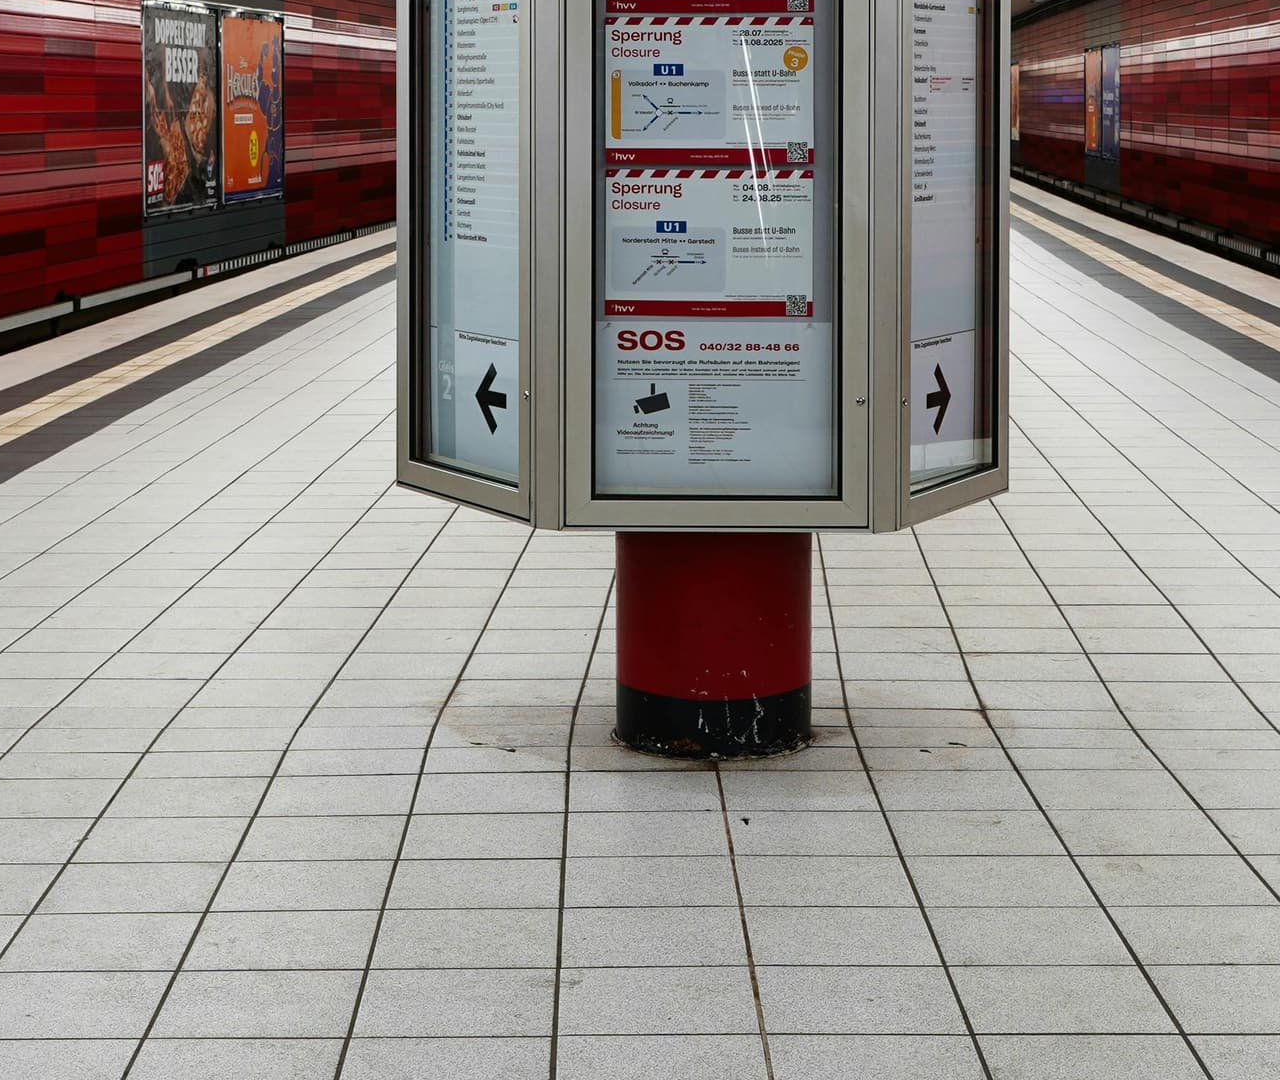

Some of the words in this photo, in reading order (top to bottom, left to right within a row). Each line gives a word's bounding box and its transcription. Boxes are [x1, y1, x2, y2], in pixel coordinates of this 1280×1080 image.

[616, 1, 636, 9] hvv
[154, 17, 185, 46] DOPPELT
[185, 20, 207, 48] SPART
[611, 30, 682, 45] Sperrung
[611, 46, 661, 58] Closure
[165, 47, 199, 83] BESSER
[791, 58, 799, 67] 3
[661, 65, 676, 75] U1
[732, 69, 752, 77] Bus
[754, 69, 771, 77] statt
[771, 69, 797, 77] U-Bahn
[226, 63, 260, 103] HERCULES
[668, 80, 710, 88] Buchenkamp
[749, 103, 772, 112] iead
[615, 152, 635, 161] hvv
[611, 182, 682, 197] Sperrung
[611, 199, 661, 210] Closure
[663, 222, 680, 232] U1
[732, 226, 753, 235] Busse
[771, 226, 796, 235] U-Bahn
[614, 304, 635, 312] hvv
[617, 329, 686, 351] SOS
[699, 343, 742, 352] 040/32
[745, 343, 781, 352] 88-48
[784, 343, 800, 352] 66
